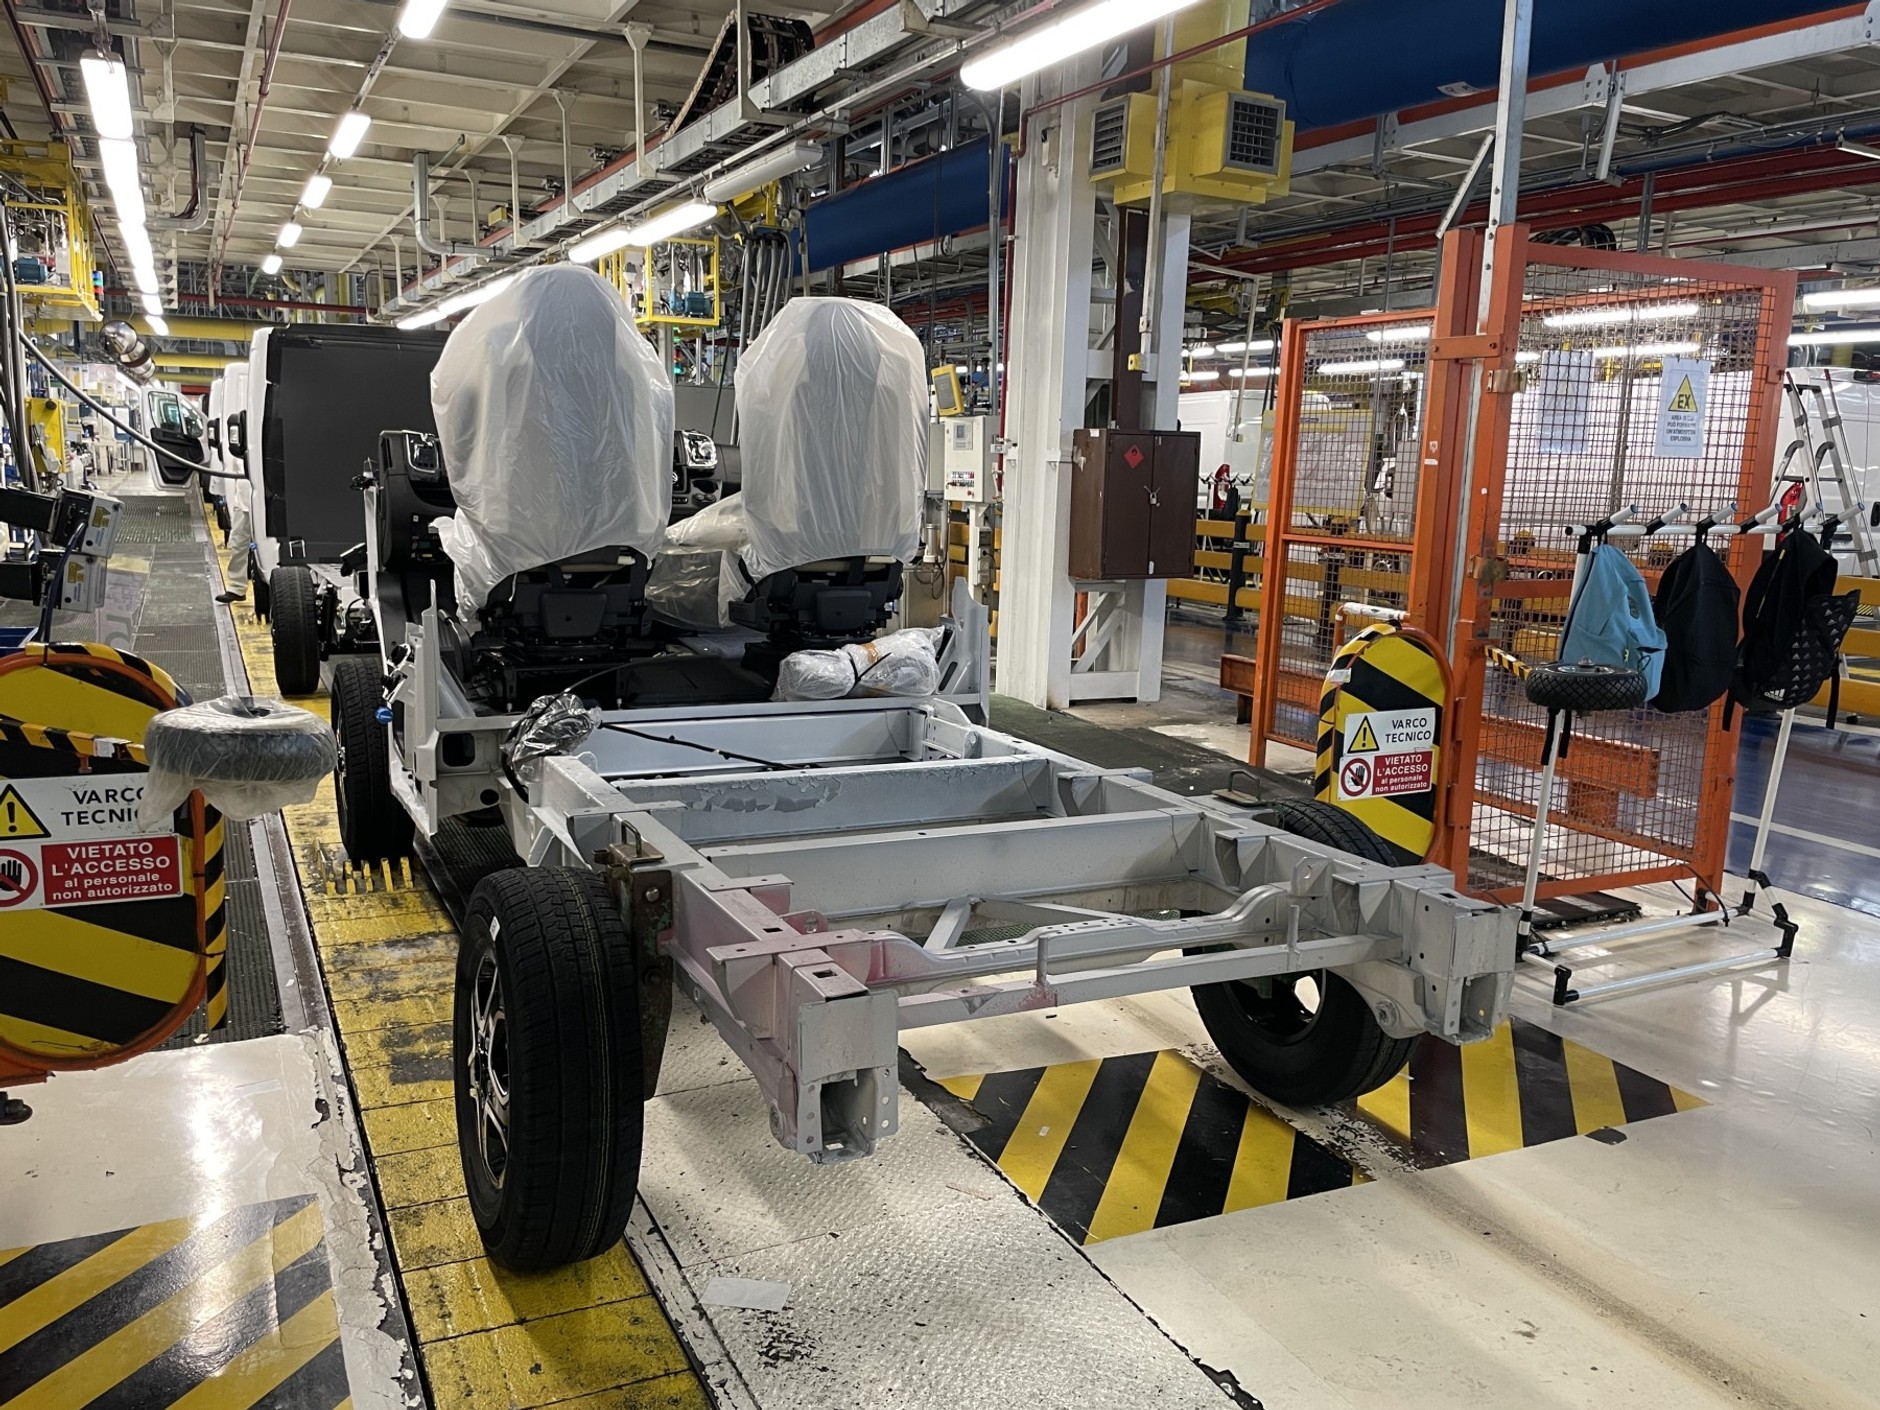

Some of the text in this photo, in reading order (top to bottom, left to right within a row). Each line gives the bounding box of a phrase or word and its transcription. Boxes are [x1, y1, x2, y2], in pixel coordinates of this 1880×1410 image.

[1677, 393, 1691, 409] EX
[1392, 718, 1427, 729] VARCO
[1385, 730, 1432, 743] TECNICO
[1385, 754, 1422, 765] VIETATO
[1377, 764, 1428, 776] L'ACCESSO
[1381, 774, 1423, 785] al personale
[1390, 781, 1428, 791] autorizzato
[61, 808, 138, 826] TECNI
[67, 842, 153, 860] VIETATO
[52, 856, 171, 877] L'ACCESSO
[64, 872, 160, 888] al personale
[52, 883, 173, 901] non autorizzato
